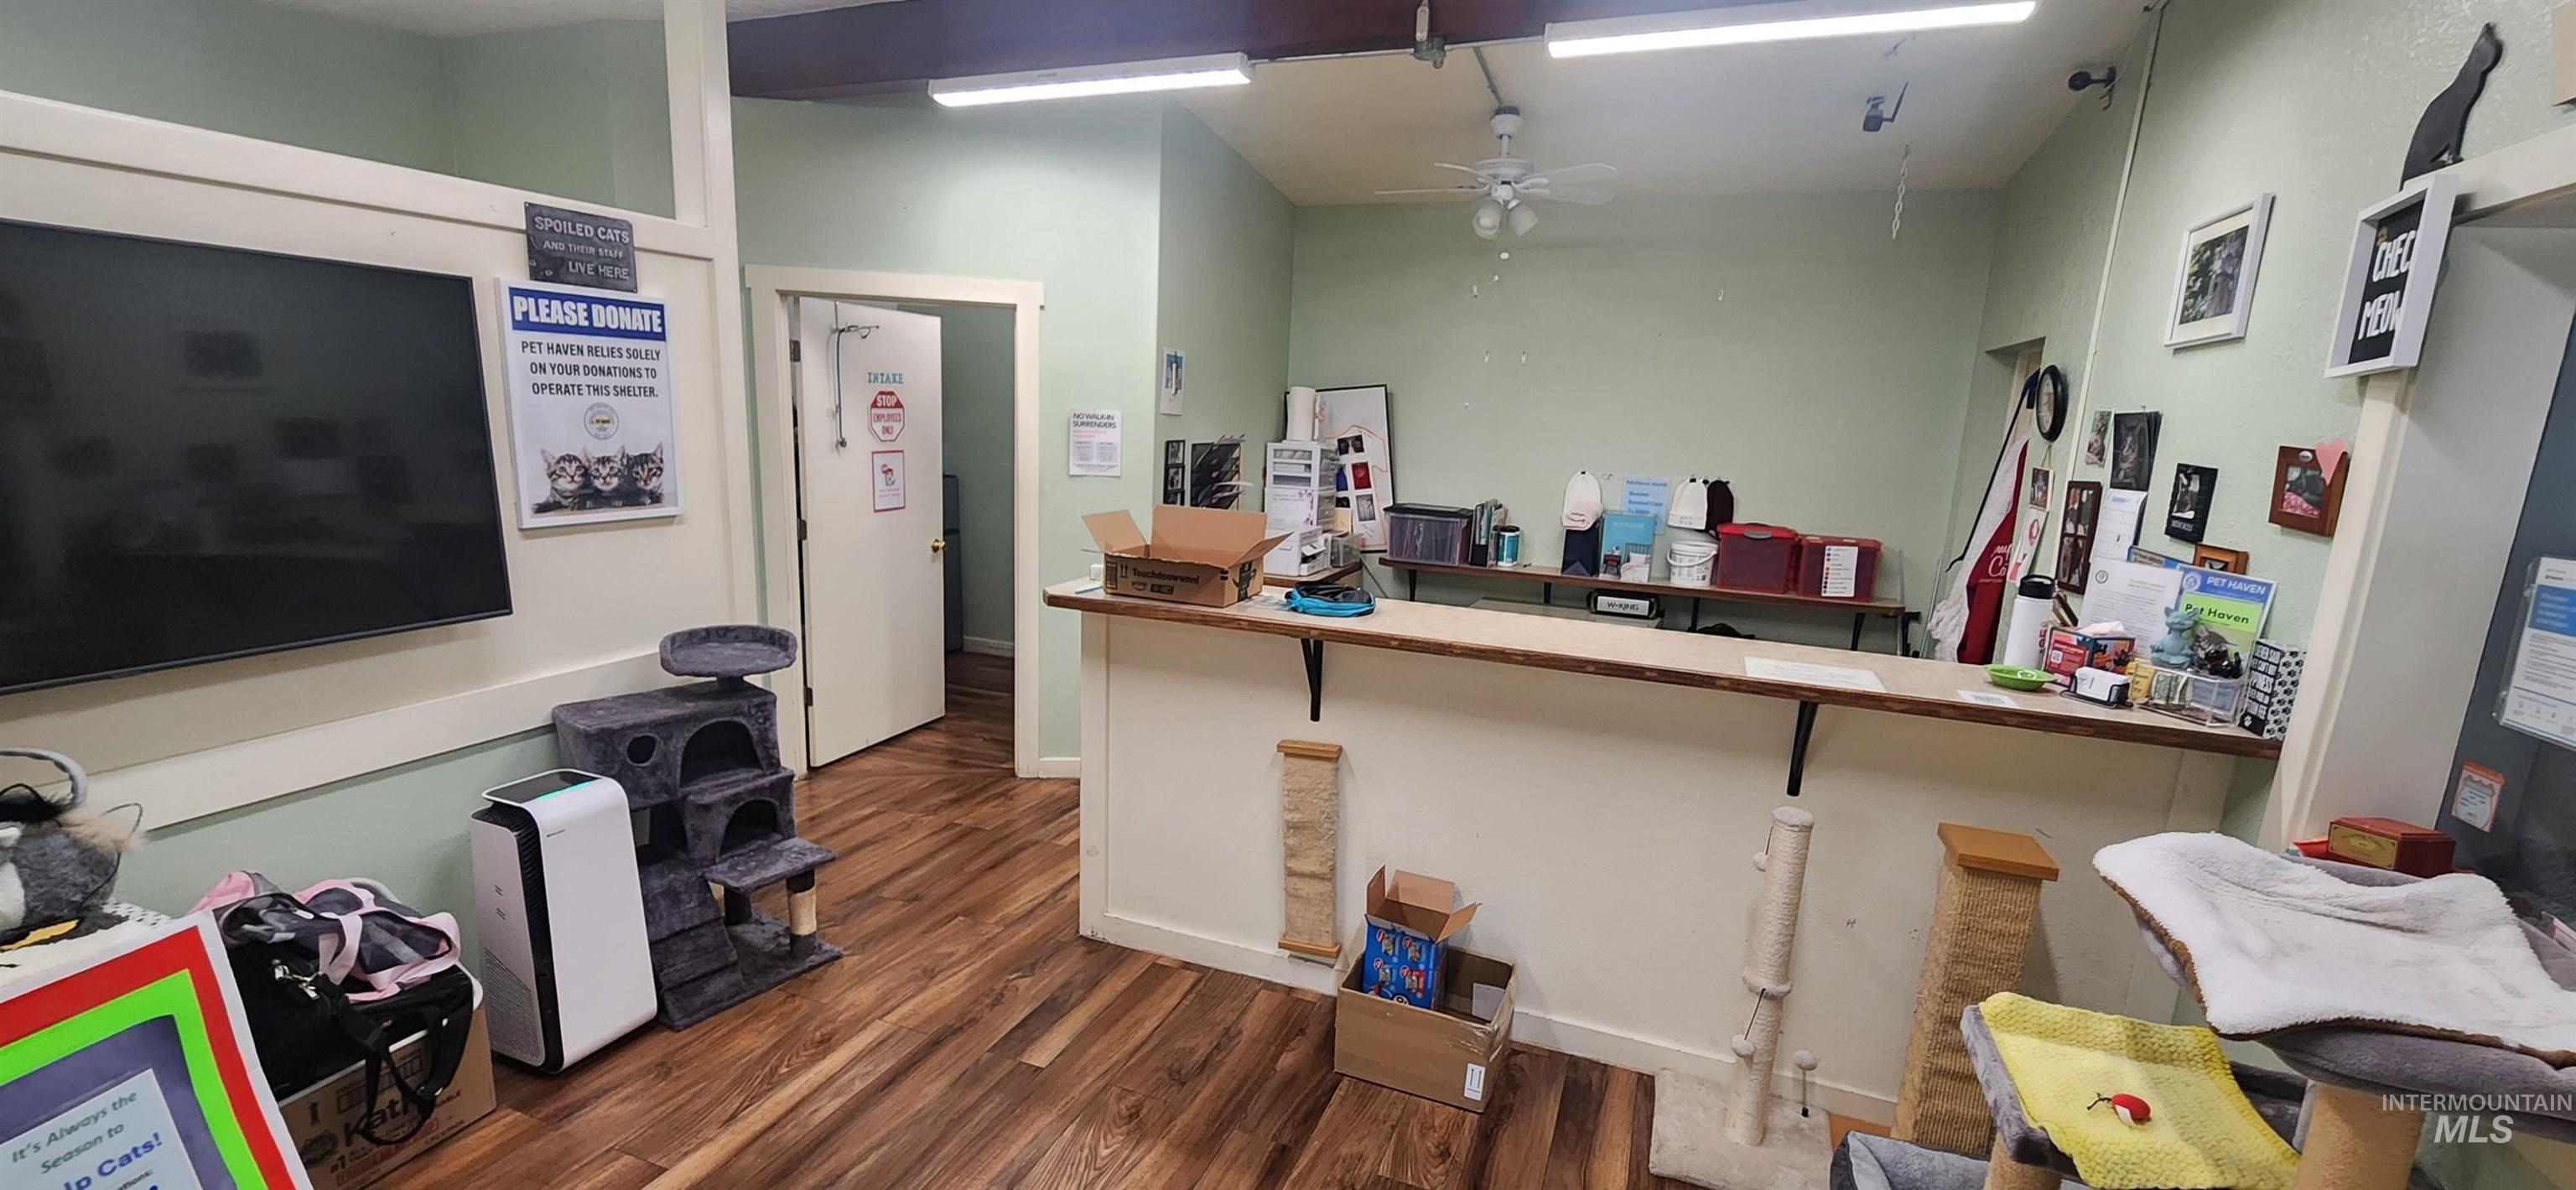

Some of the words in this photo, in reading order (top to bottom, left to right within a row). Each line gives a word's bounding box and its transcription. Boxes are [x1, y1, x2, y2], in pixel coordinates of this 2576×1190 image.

[533, 216, 594, 238] SPOILED
[597, 226, 630, 244] CATS
[543, 240, 565, 251] AND
[568, 243, 595, 255] THEIR
[599, 247, 623, 259] STAFF
[2372, 230, 2417, 282] CHEC
[569, 261, 595, 275] LIVE
[599, 265, 630, 279] HERE
[513, 295, 589, 327] PLEASE
[591, 304, 663, 333] DONATE
[521, 340, 543, 355] PET
[547, 342, 584, 356] HAVEN
[587, 345, 624, 359] RELIES
[626, 348, 661, 361] SOLELY
[530, 362, 547, 375] ON
[548, 362, 580, 377] YOUR
[583, 364, 643, 378] DONATIONS
[645, 367, 657, 379] TO
[867, 372, 904, 384] INTAKE
[532, 382, 584, 396] OPERATE
[586, 384, 610, 397] THIS
[613, 385, 659, 398] SHELTER.
[875, 394, 898, 408] STOP
[2206, 576, 2228, 587] PET
[2227, 580, 2267, 595] HAVEN
[2184, 603, 2205, 615] Pt
[2208, 607, 2250, 624] Haven
[12, 1141, 41, 1162] It's
[47, 1107, 108, 1146] Always
[112, 1092, 137, 1111] the
[41, 1135, 103, 1173] Season
[107, 1123, 125, 1139] to
[96, 1131, 164, 1177] Cats!
